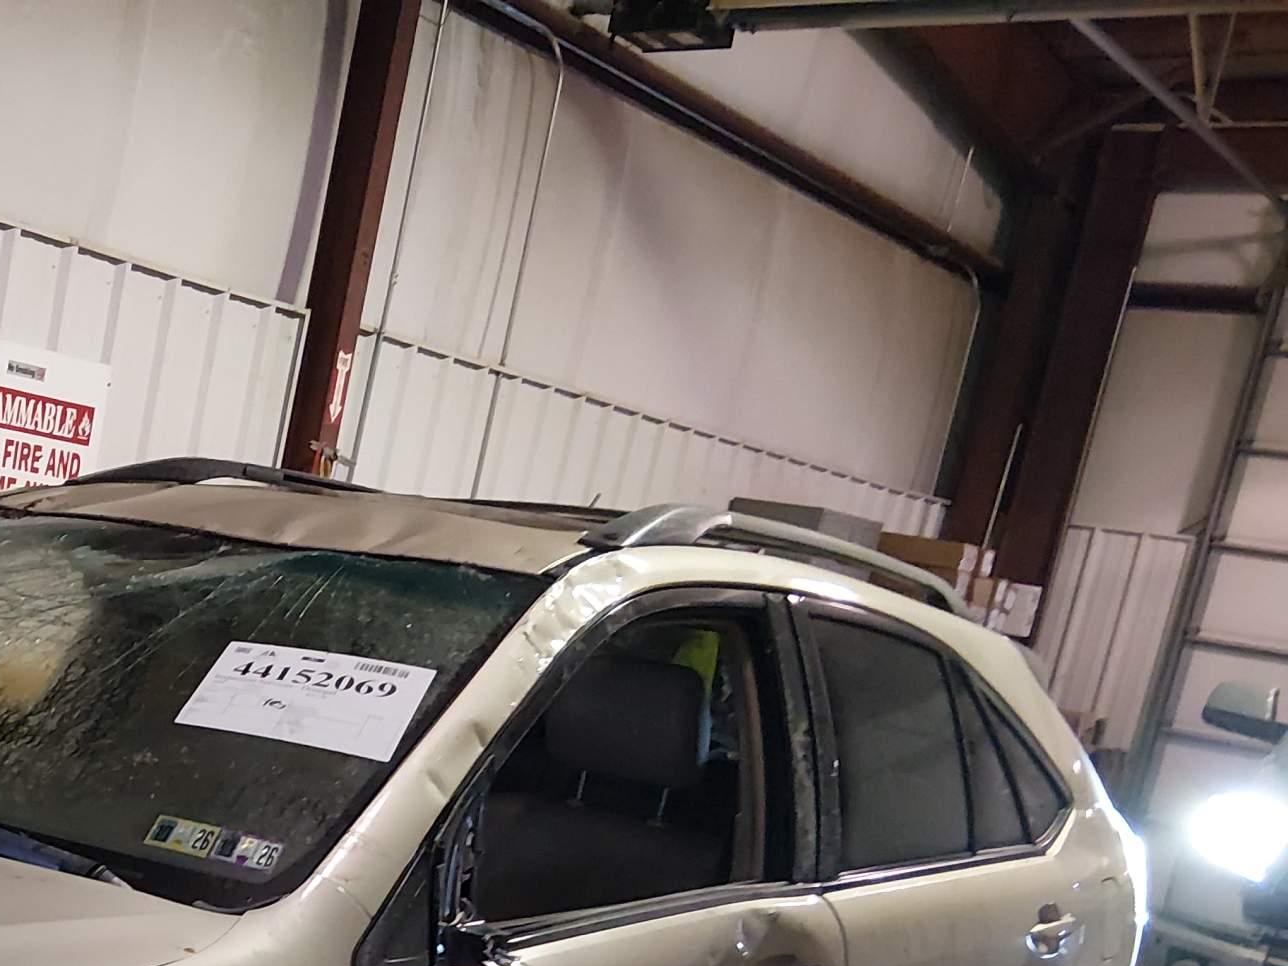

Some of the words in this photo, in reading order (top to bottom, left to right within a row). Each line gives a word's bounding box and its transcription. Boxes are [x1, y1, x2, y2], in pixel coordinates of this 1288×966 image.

[2, 439, 43, 474] FIRE
[44, 448, 81, 480] AND
[232, 661, 398, 698] 44152069
[192, 828, 214, 851] 26
[256, 844, 279, 867] 26
